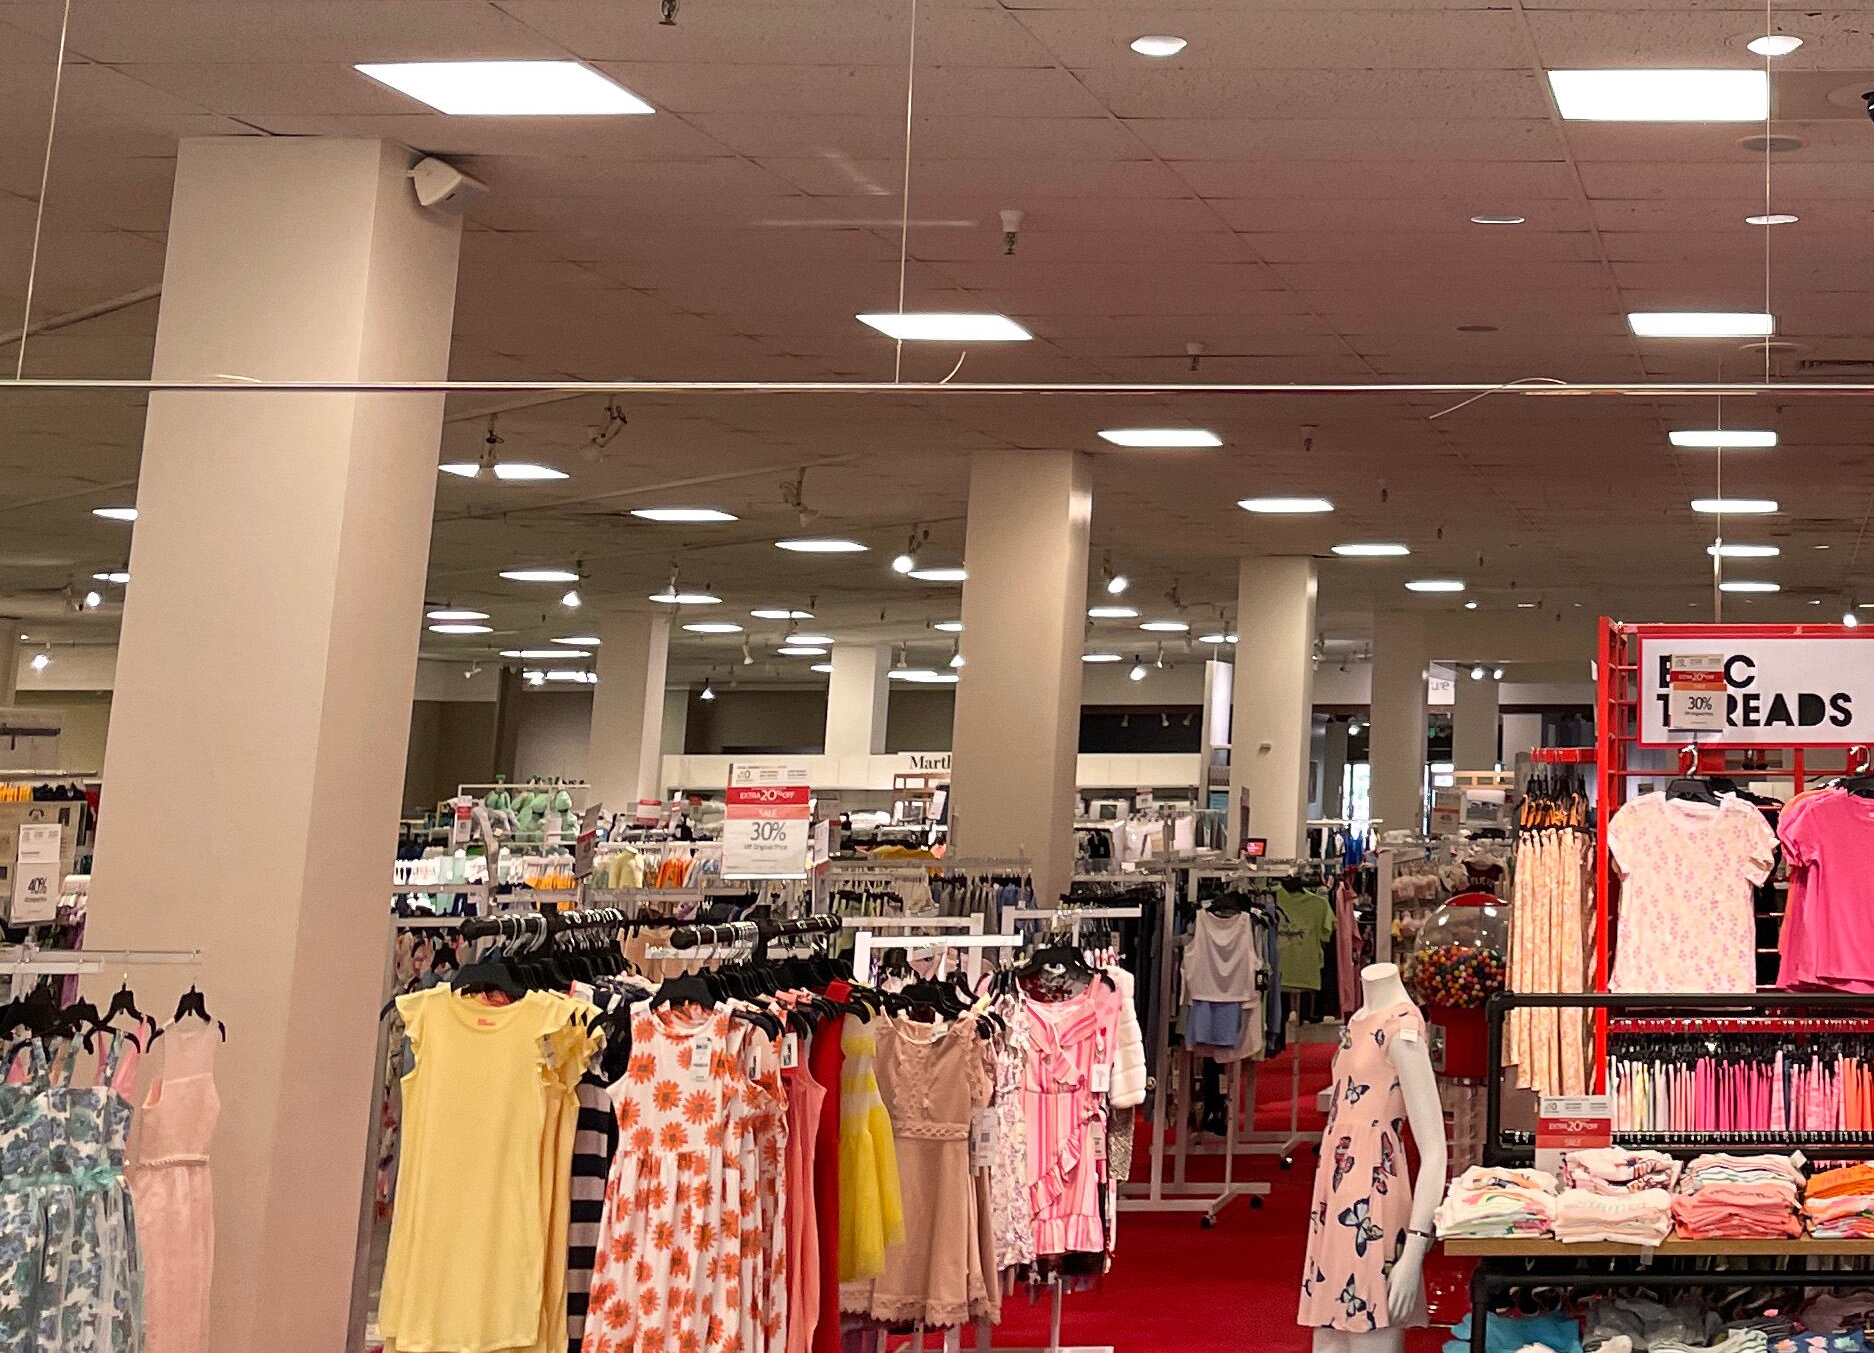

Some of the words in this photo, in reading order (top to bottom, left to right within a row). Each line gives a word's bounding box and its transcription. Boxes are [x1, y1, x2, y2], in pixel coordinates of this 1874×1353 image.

[1659, 655, 1756, 688] EC
[1656, 692, 1854, 727] TREADS
[1688, 696, 1713, 710] 30%
[750, 821, 787, 842] 30%
